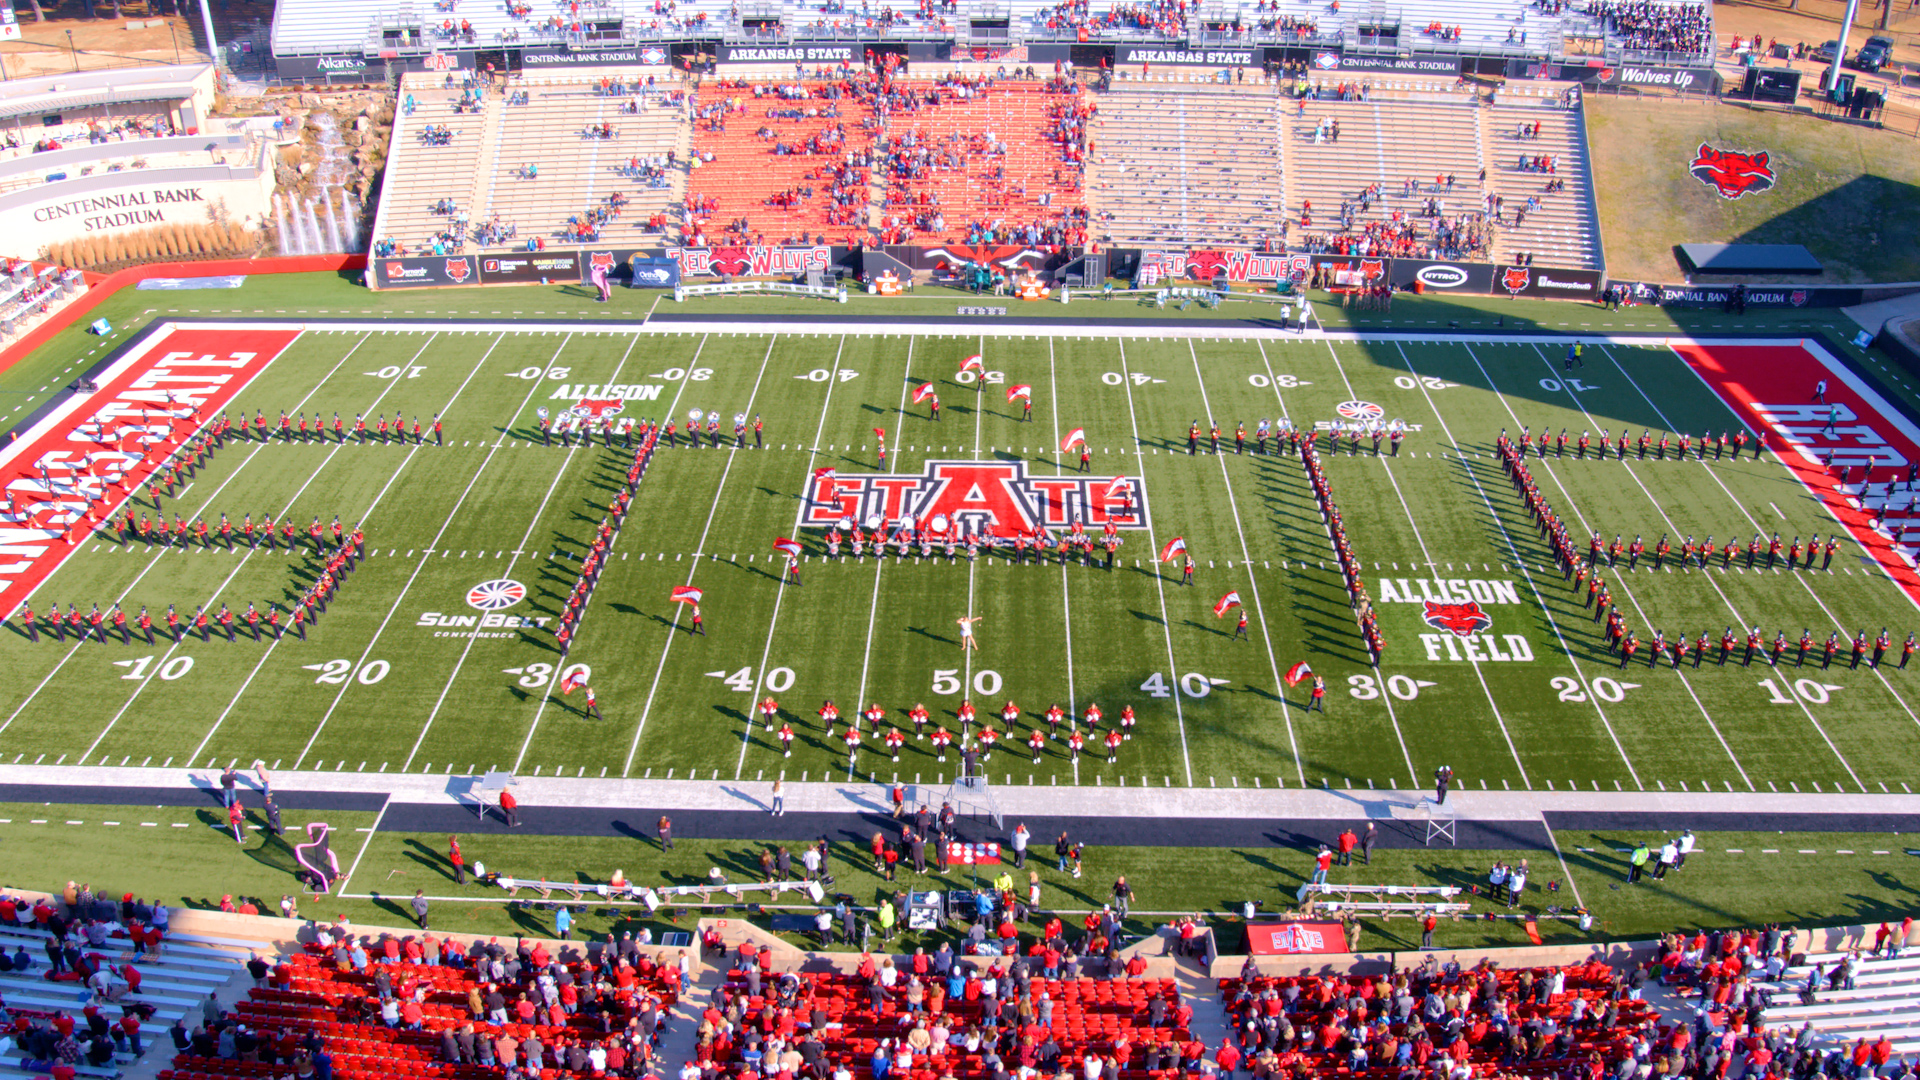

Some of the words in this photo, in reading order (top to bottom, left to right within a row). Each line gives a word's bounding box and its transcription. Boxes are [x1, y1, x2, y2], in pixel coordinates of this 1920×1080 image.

[317, 57, 367, 69] Arkansas
[424, 53, 458, 71] STATE
[525, 54, 575, 63] CENTENNIAL
[577, 54, 599, 62] BANK
[601, 53, 637, 62] STADIUM
[728, 48, 804, 60] ARKANSAS
[807, 48, 851, 60] STATE
[1127, 50, 1204, 63] ARKANSAS
[1207, 52, 1251, 64] STATE
[1342, 58, 1393, 68] CENTENNIAL
[1395, 59, 1417, 69] BANK
[1418, 61, 1456, 71] STADIUM
[1621, 68, 1671, 84] Wolves
[1673, 73, 1694, 88] Up
[34, 191, 150, 222] CENTENNIAL
[153, 188, 205, 204] BANK
[84, 209, 165, 232] STADIUM
[667, 249, 709, 277] RED
[750, 247, 832, 277] WOLVES
[1225, 251, 1310, 281] WOLVES
[1424, 272, 1460, 281] HYTROL
[1546, 280, 1592, 290] BancorpSouth
[377, 365, 427, 379] 10
[519, 366, 571, 380] 20
[662, 367, 714, 381] 30
[808, 369, 859, 382] 40
[955, 370, 1005, 384] 50
[1101, 372, 1152, 386] 40
[1248, 374, 1299, 388] 30
[549, 384, 664, 400] ALLISON
[1393, 376, 1447, 390] 20
[1538, 378, 1587, 392] 10
[66, 352, 257, 443] STATE
[1749, 402, 1909, 467] RED
[802, 460, 1151, 547] STATE
[1380, 578, 1521, 604] ALLISON
[416, 612, 477, 627] SUN
[482, 613, 551, 628] BELT
[434, 631, 516, 639] CONFERENCE
[1418, 633, 1535, 662] FIELD
[121, 655, 194, 681] 10
[315, 659, 390, 685] 20
[519, 663, 592, 688] 30
[724, 666, 796, 692] 40
[931, 669, 1003, 695] 50
[1140, 672, 1211, 698] 40
[1348, 674, 1419, 700] 30
[1550, 676, 1625, 702] 20
[1758, 678, 1830, 704] 10
[1271, 924, 1324, 951] STATE
